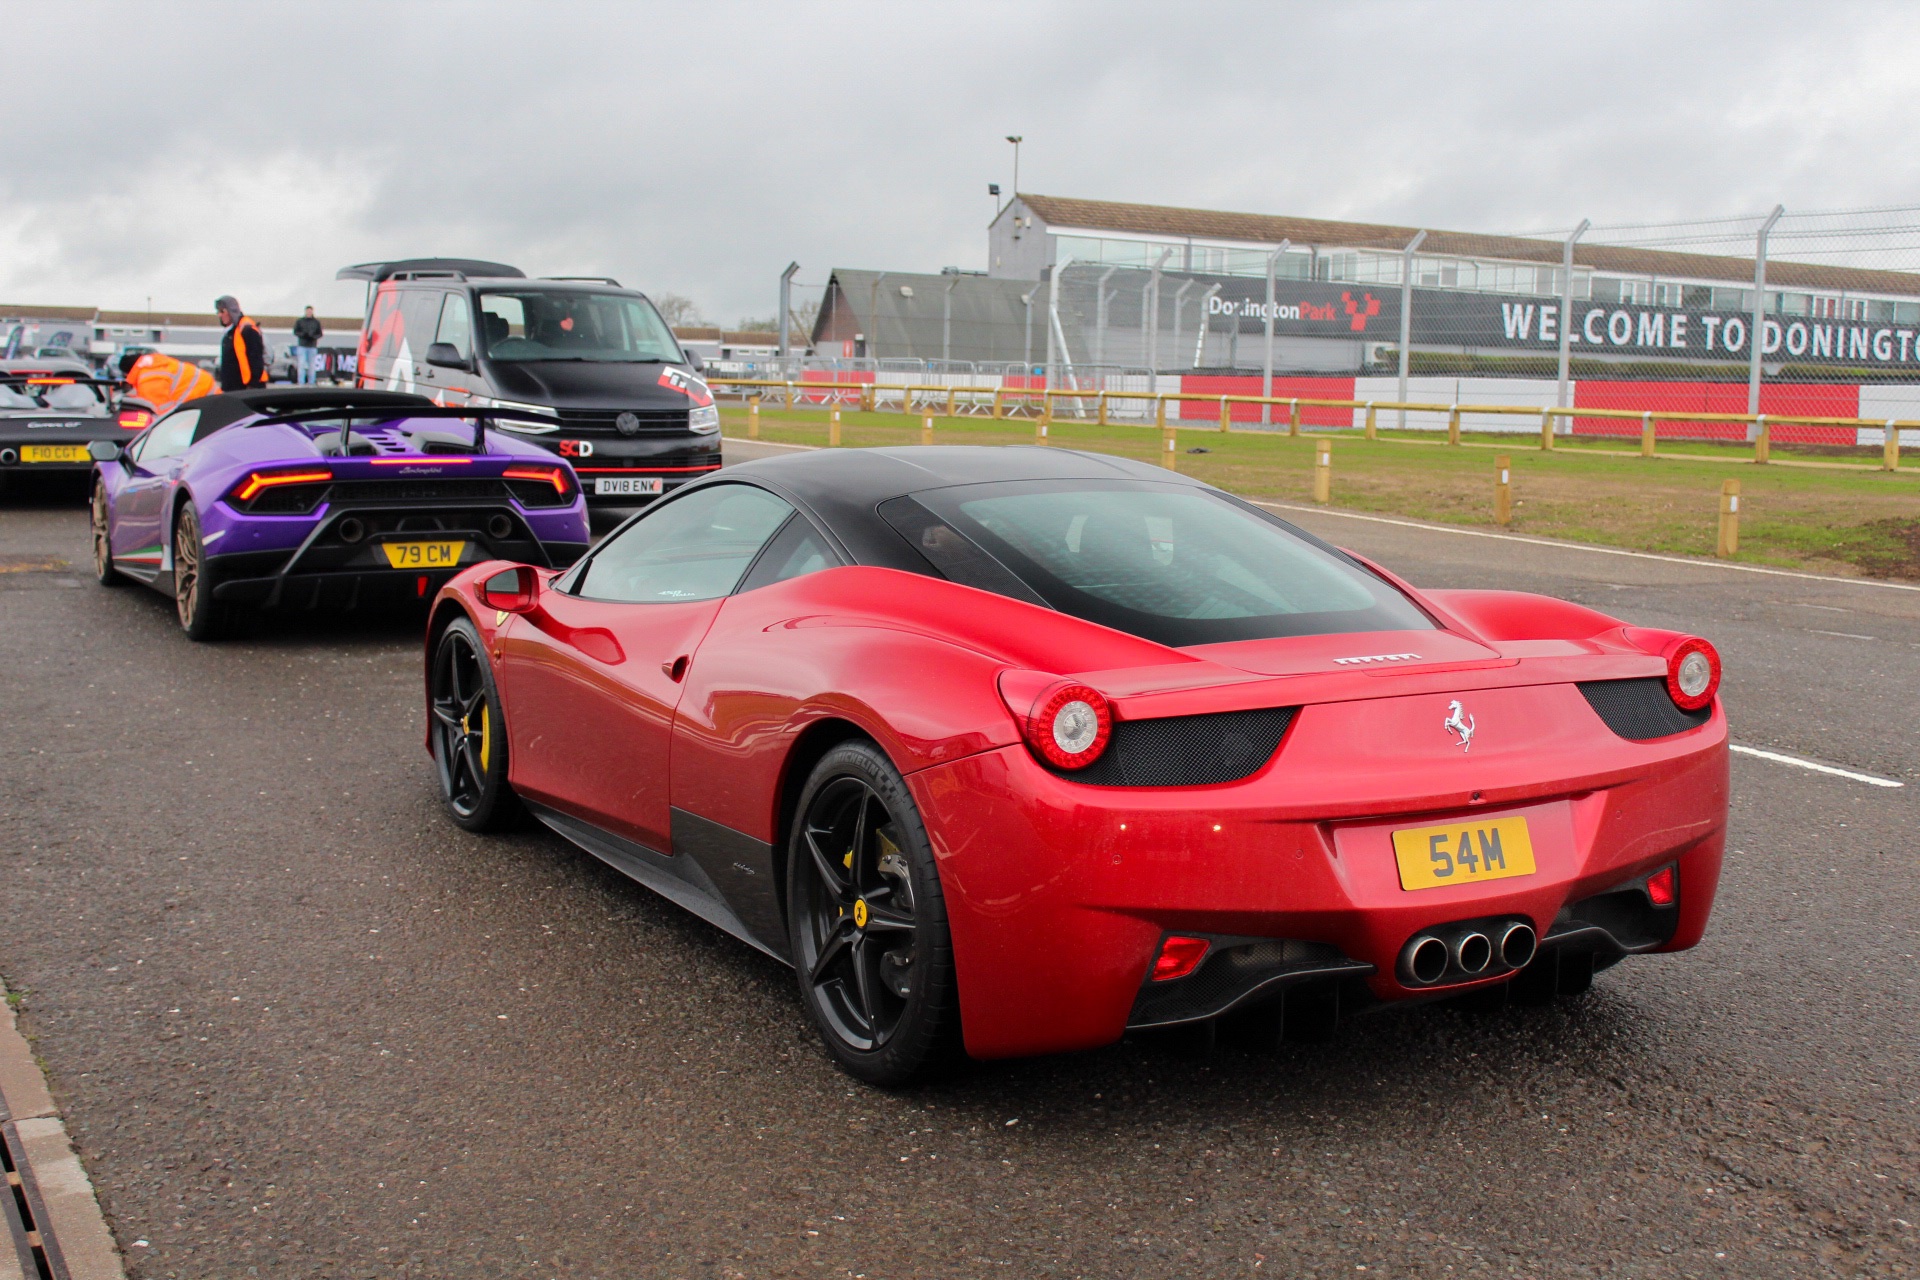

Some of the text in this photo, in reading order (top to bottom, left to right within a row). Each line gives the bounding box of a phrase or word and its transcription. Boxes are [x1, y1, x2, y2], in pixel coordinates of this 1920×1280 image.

[1502, 303, 1920, 362] WECOME TO DONINGT
[55, 447, 77, 458] CGT
[559, 440, 593, 457] SCD
[604, 481, 629, 491] DV18
[397, 545, 451, 563] 79 CM
[1429, 828, 1506, 877] 54M
